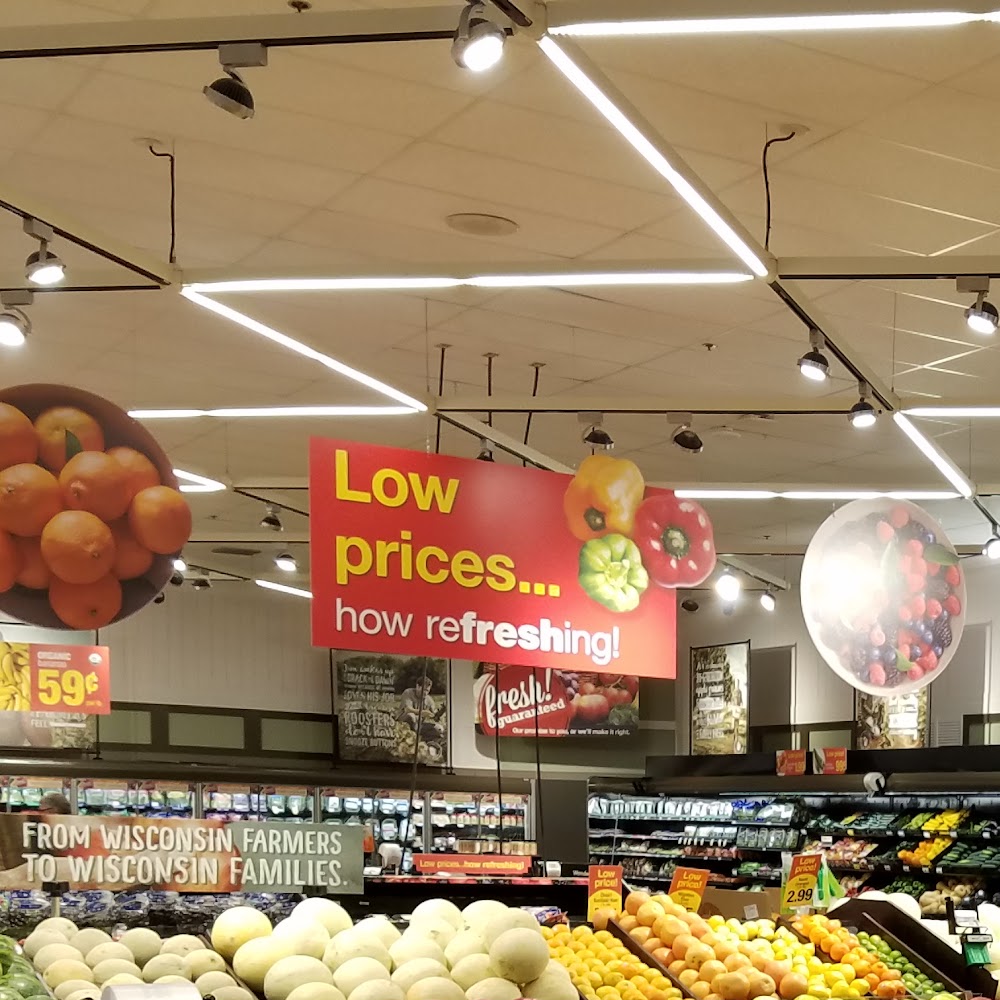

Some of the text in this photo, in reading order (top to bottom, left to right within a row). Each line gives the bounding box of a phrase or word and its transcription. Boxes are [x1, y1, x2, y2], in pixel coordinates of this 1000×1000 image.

[335, 449, 460, 513] Low
[336, 531, 560, 597] prices...
[335, 598, 413, 637] how
[427, 611, 620, 665] refreshing!
[38, 669, 99, 706] 59¢
[498, 698, 566, 729] guaranteed
[22, 821, 342, 855] FROM WISCONSIN FARMERS
[21, 853, 348, 887] TO WISCONSIN FAMILIES.
[594, 878, 618, 889] price!
[597, 869, 615, 878] Low
[683, 871, 702, 880] Low
[787, 888, 813, 903] 2.99
